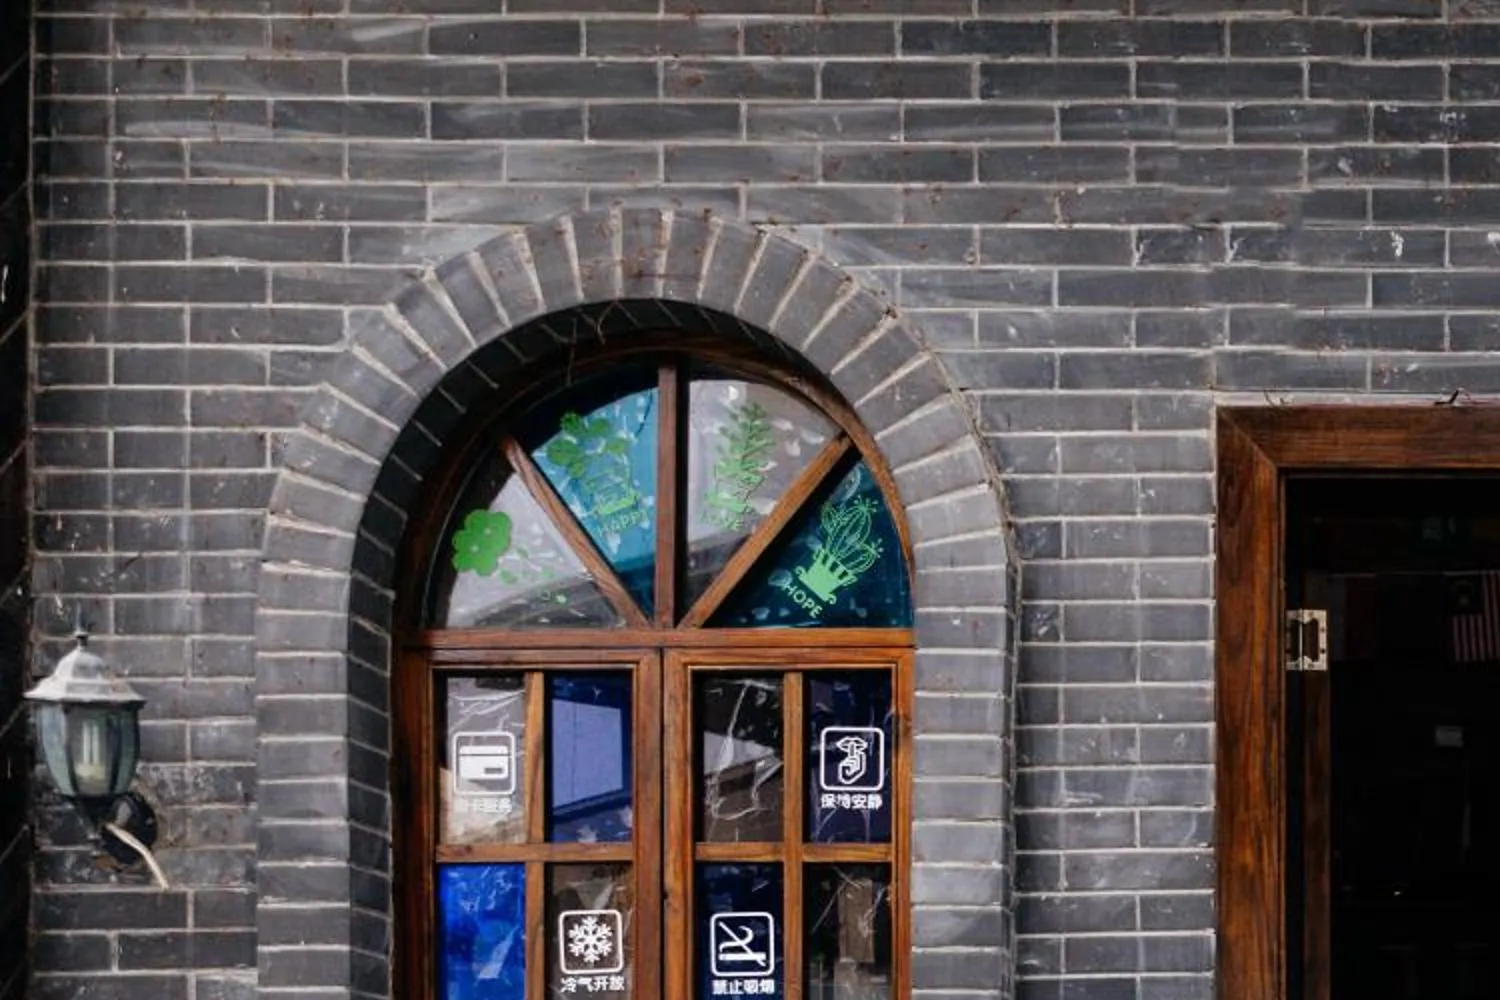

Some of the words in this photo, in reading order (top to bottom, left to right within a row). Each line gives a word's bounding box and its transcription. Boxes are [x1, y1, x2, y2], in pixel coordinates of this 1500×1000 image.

[782, 584, 823, 619] HOPE
[821, 792, 883, 809] 保持安静
[560, 975, 625, 993] 冷气开放
[712, 978, 776, 996] 禁止吸烟
